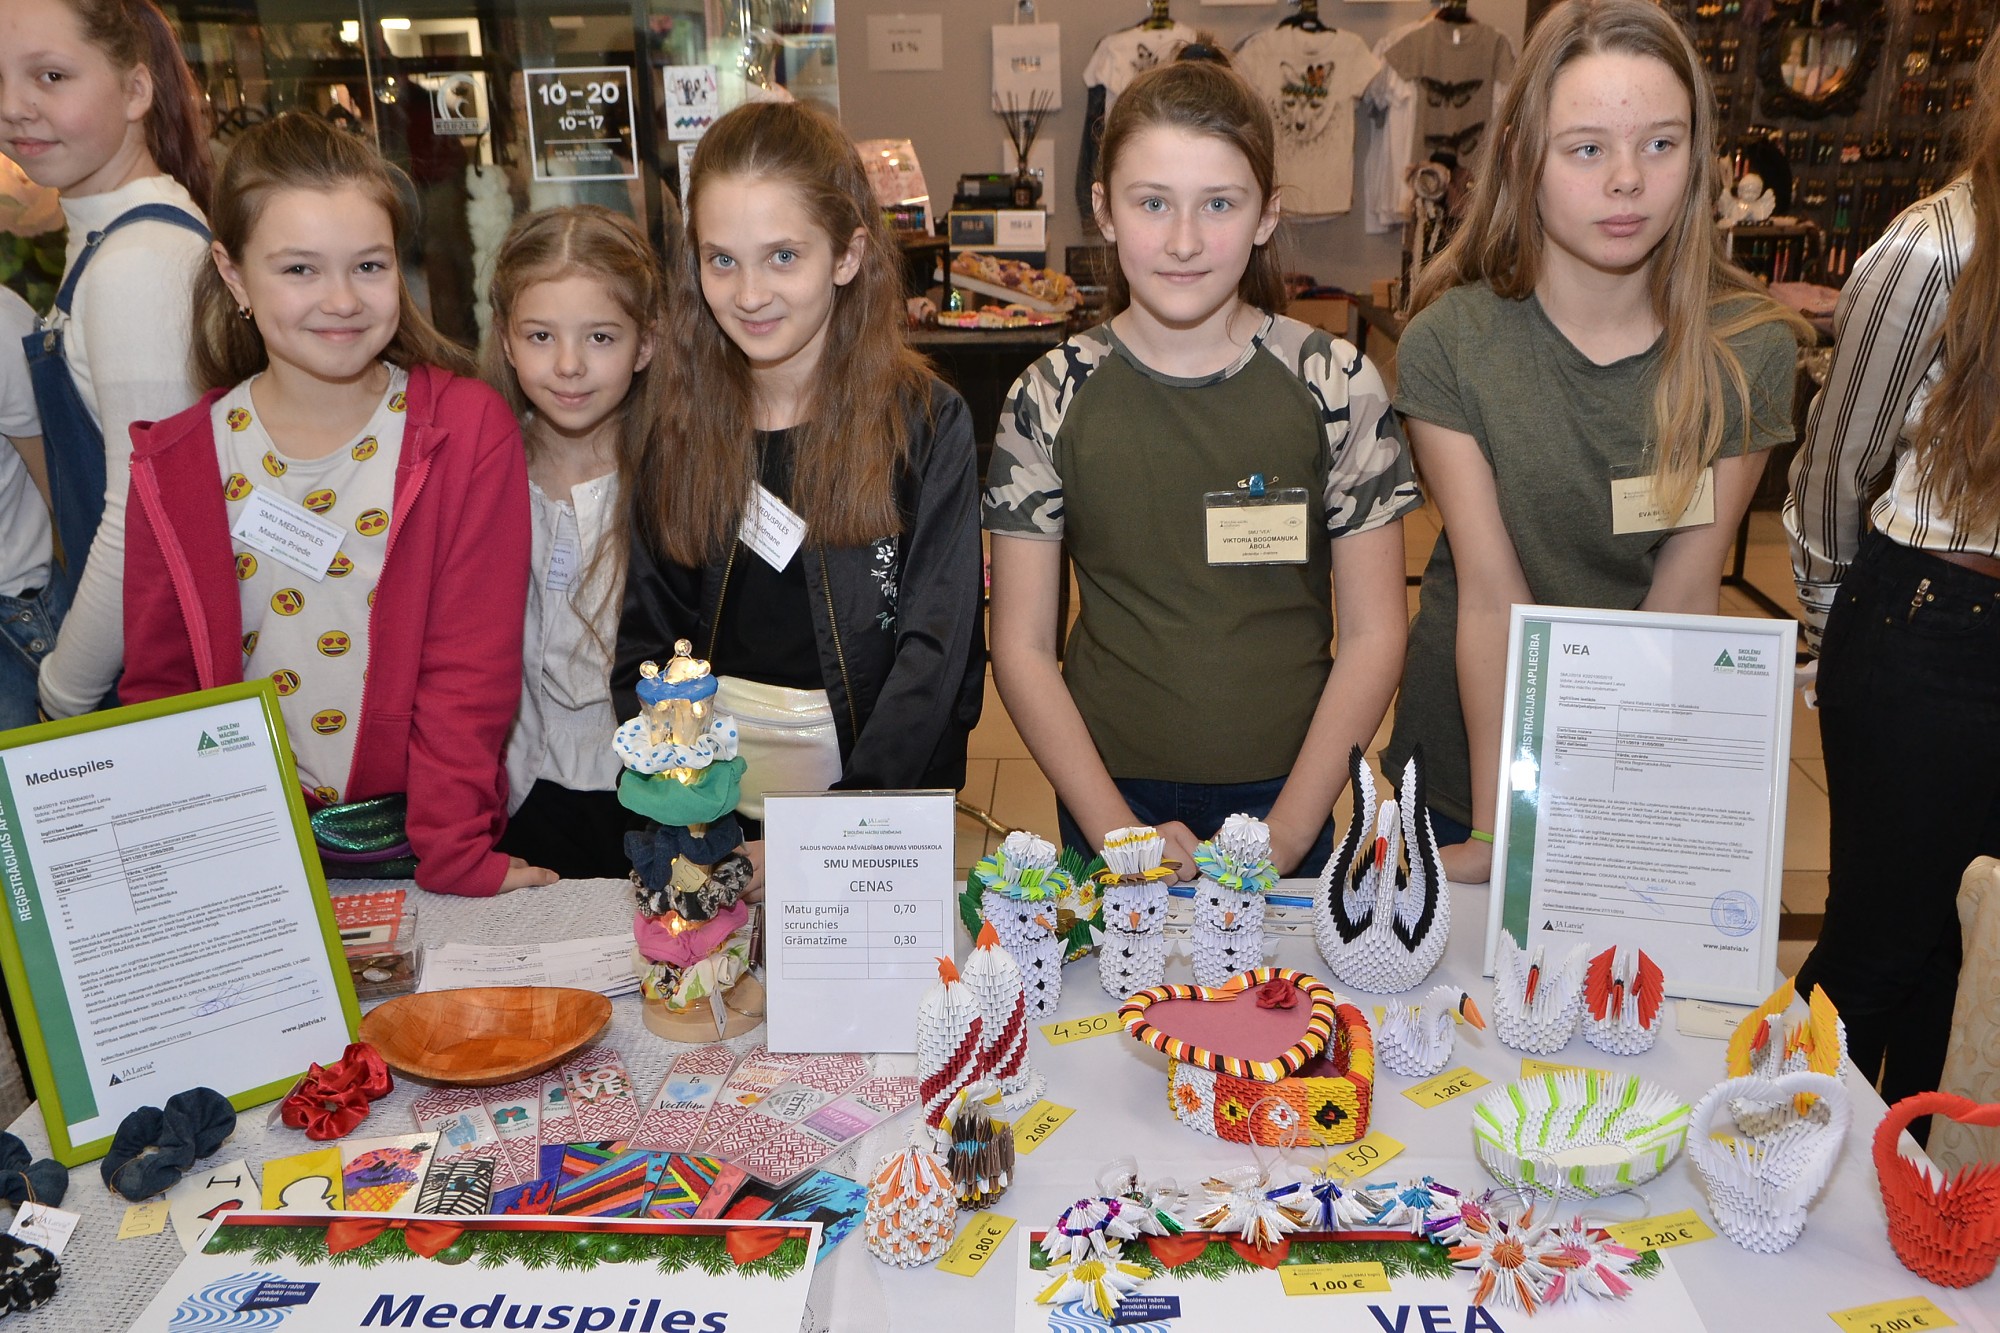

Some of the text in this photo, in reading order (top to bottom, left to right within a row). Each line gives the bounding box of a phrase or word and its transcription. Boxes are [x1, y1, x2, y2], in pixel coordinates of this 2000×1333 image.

[259, 509, 278, 523] SMU
[278, 519, 325, 547] MEDUSPILES
[259, 526, 312, 557] Madara Priede
[1562, 643, 1590, 655] VEA
[1527, 633, 1540, 686] APLIECĪBA
[25, 759, 114, 786] Meduspiles
[846, 843, 884, 851] PAŠVALDĪBAS
[823, 858, 919, 869] SMU MEDUSPILES
[850, 880, 893, 893] CENAS
[784, 904, 850, 916] Matu gumija
[893, 904, 917, 915] 0,70
[784, 920, 839, 930] scrunchies
[784, 935, 848, 945] Grāmatzīme
[894, 936, 917, 947] 0,30
[1702, 940, 1748, 954] www.jalatvia.lv
[281, 1015, 326, 1033] www.jalatvia.lv
[1053, 1017, 1108, 1039] 4.50
[689, 1076, 700, 1084] Es
[1434, 1080, 1472, 1100] 1,20 €
[1026, 1116, 1060, 1143] 2,00 €
[968, 1235, 995, 1261] 0,80
[988, 1226, 1002, 1237] €
[1640, 1228, 1693, 1248] 2,20 €
[1309, 1279, 1366, 1292] 1,00 €
[359, 1293, 729, 1333] Meduspiles
[1366, 1304, 1506, 1333] VEA
[1913, 1314, 1929, 1326] €
